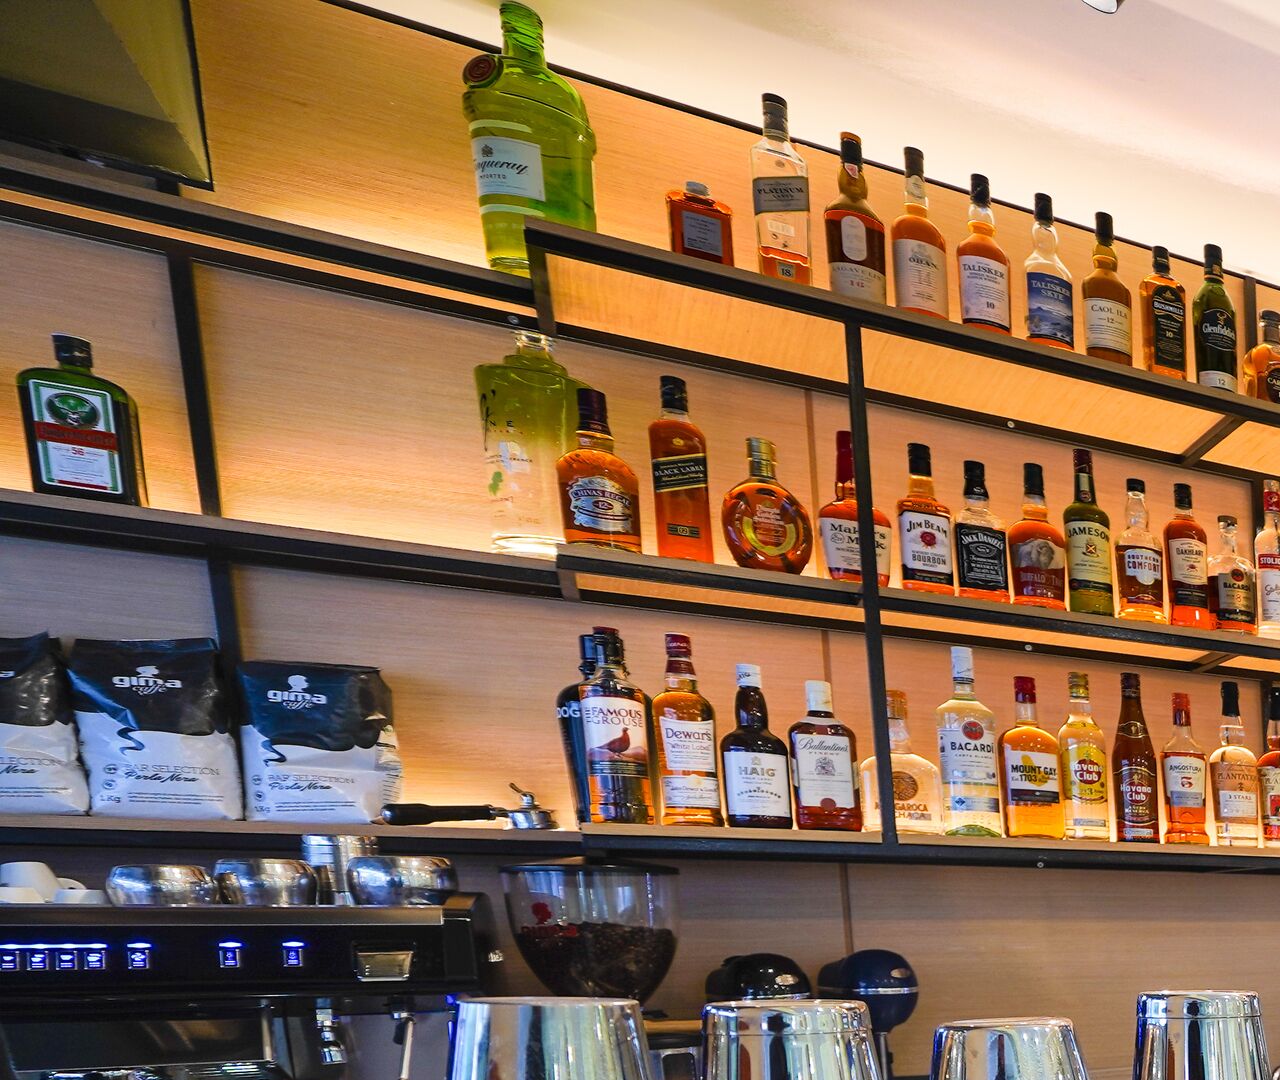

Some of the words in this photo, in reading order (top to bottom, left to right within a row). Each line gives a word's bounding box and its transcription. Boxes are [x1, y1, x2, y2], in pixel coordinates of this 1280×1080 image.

[781, 268, 792, 277] 18
[962, 263, 1005, 279] TALISKER
[1031, 280, 1071, 297] TALISKER
[986, 301, 995, 310] 10
[1091, 303, 1114, 315] CAOL
[1217, 378, 1226, 386] 12
[655, 468, 679, 477] BLACK
[571, 489, 604, 499] CHIVAS
[604, 491, 631, 507] REGAL
[906, 520, 922, 533] JIM
[924, 519, 947, 538] BEAM
[845, 536, 886, 550] Mk
[961, 533, 977, 544] JACK
[912, 553, 946, 566] BOURBON
[1127, 554, 1159, 562] SOUTHERN
[1127, 561, 1160, 573] COMFORT
[112, 674, 182, 690] gima
[267, 690, 328, 704] gima
[592, 707, 642, 720] FAMOUS
[591, 717, 643, 728] GROUSE
[665, 727, 713, 742] Dewar's
[799, 737, 848, 752] Ballantine's
[152, 764, 220, 776] SELECTION
[739, 766, 776, 777] HAIG
[1011, 765, 1041, 775] MOUNT
[1043, 767, 1057, 776] GAY
[1076, 770, 1099, 780] Club
[293, 775, 355, 785] SELECTION
[1019, 774, 1038, 783] 1703
[1120, 784, 1152, 793] Havana
[1126, 791, 1147, 801] Club
